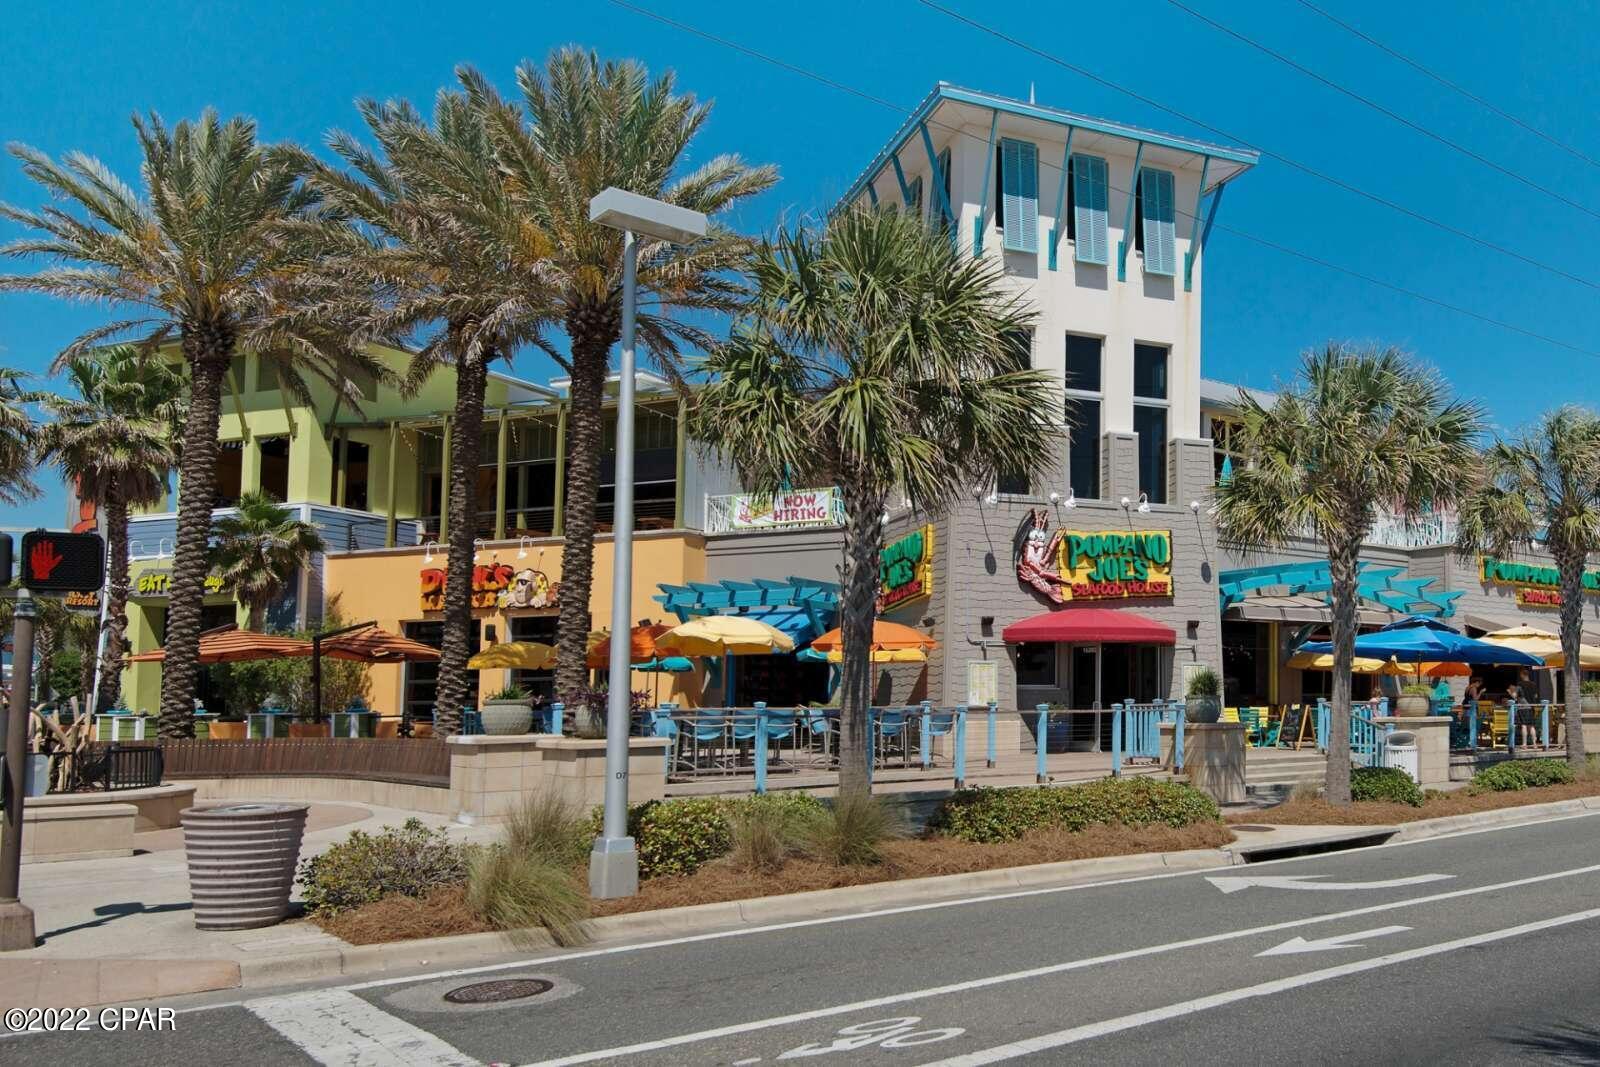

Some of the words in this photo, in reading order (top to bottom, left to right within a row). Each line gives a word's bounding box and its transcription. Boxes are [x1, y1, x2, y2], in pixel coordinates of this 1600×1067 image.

[772, 506, 827, 521] HIRING
[1065, 534, 1168, 569] POMPANO
[1483, 556, 1561, 585] POMPAN
[1071, 583, 1124, 596] SEAFOOD
[1126, 581, 1169, 594] HOUSE
